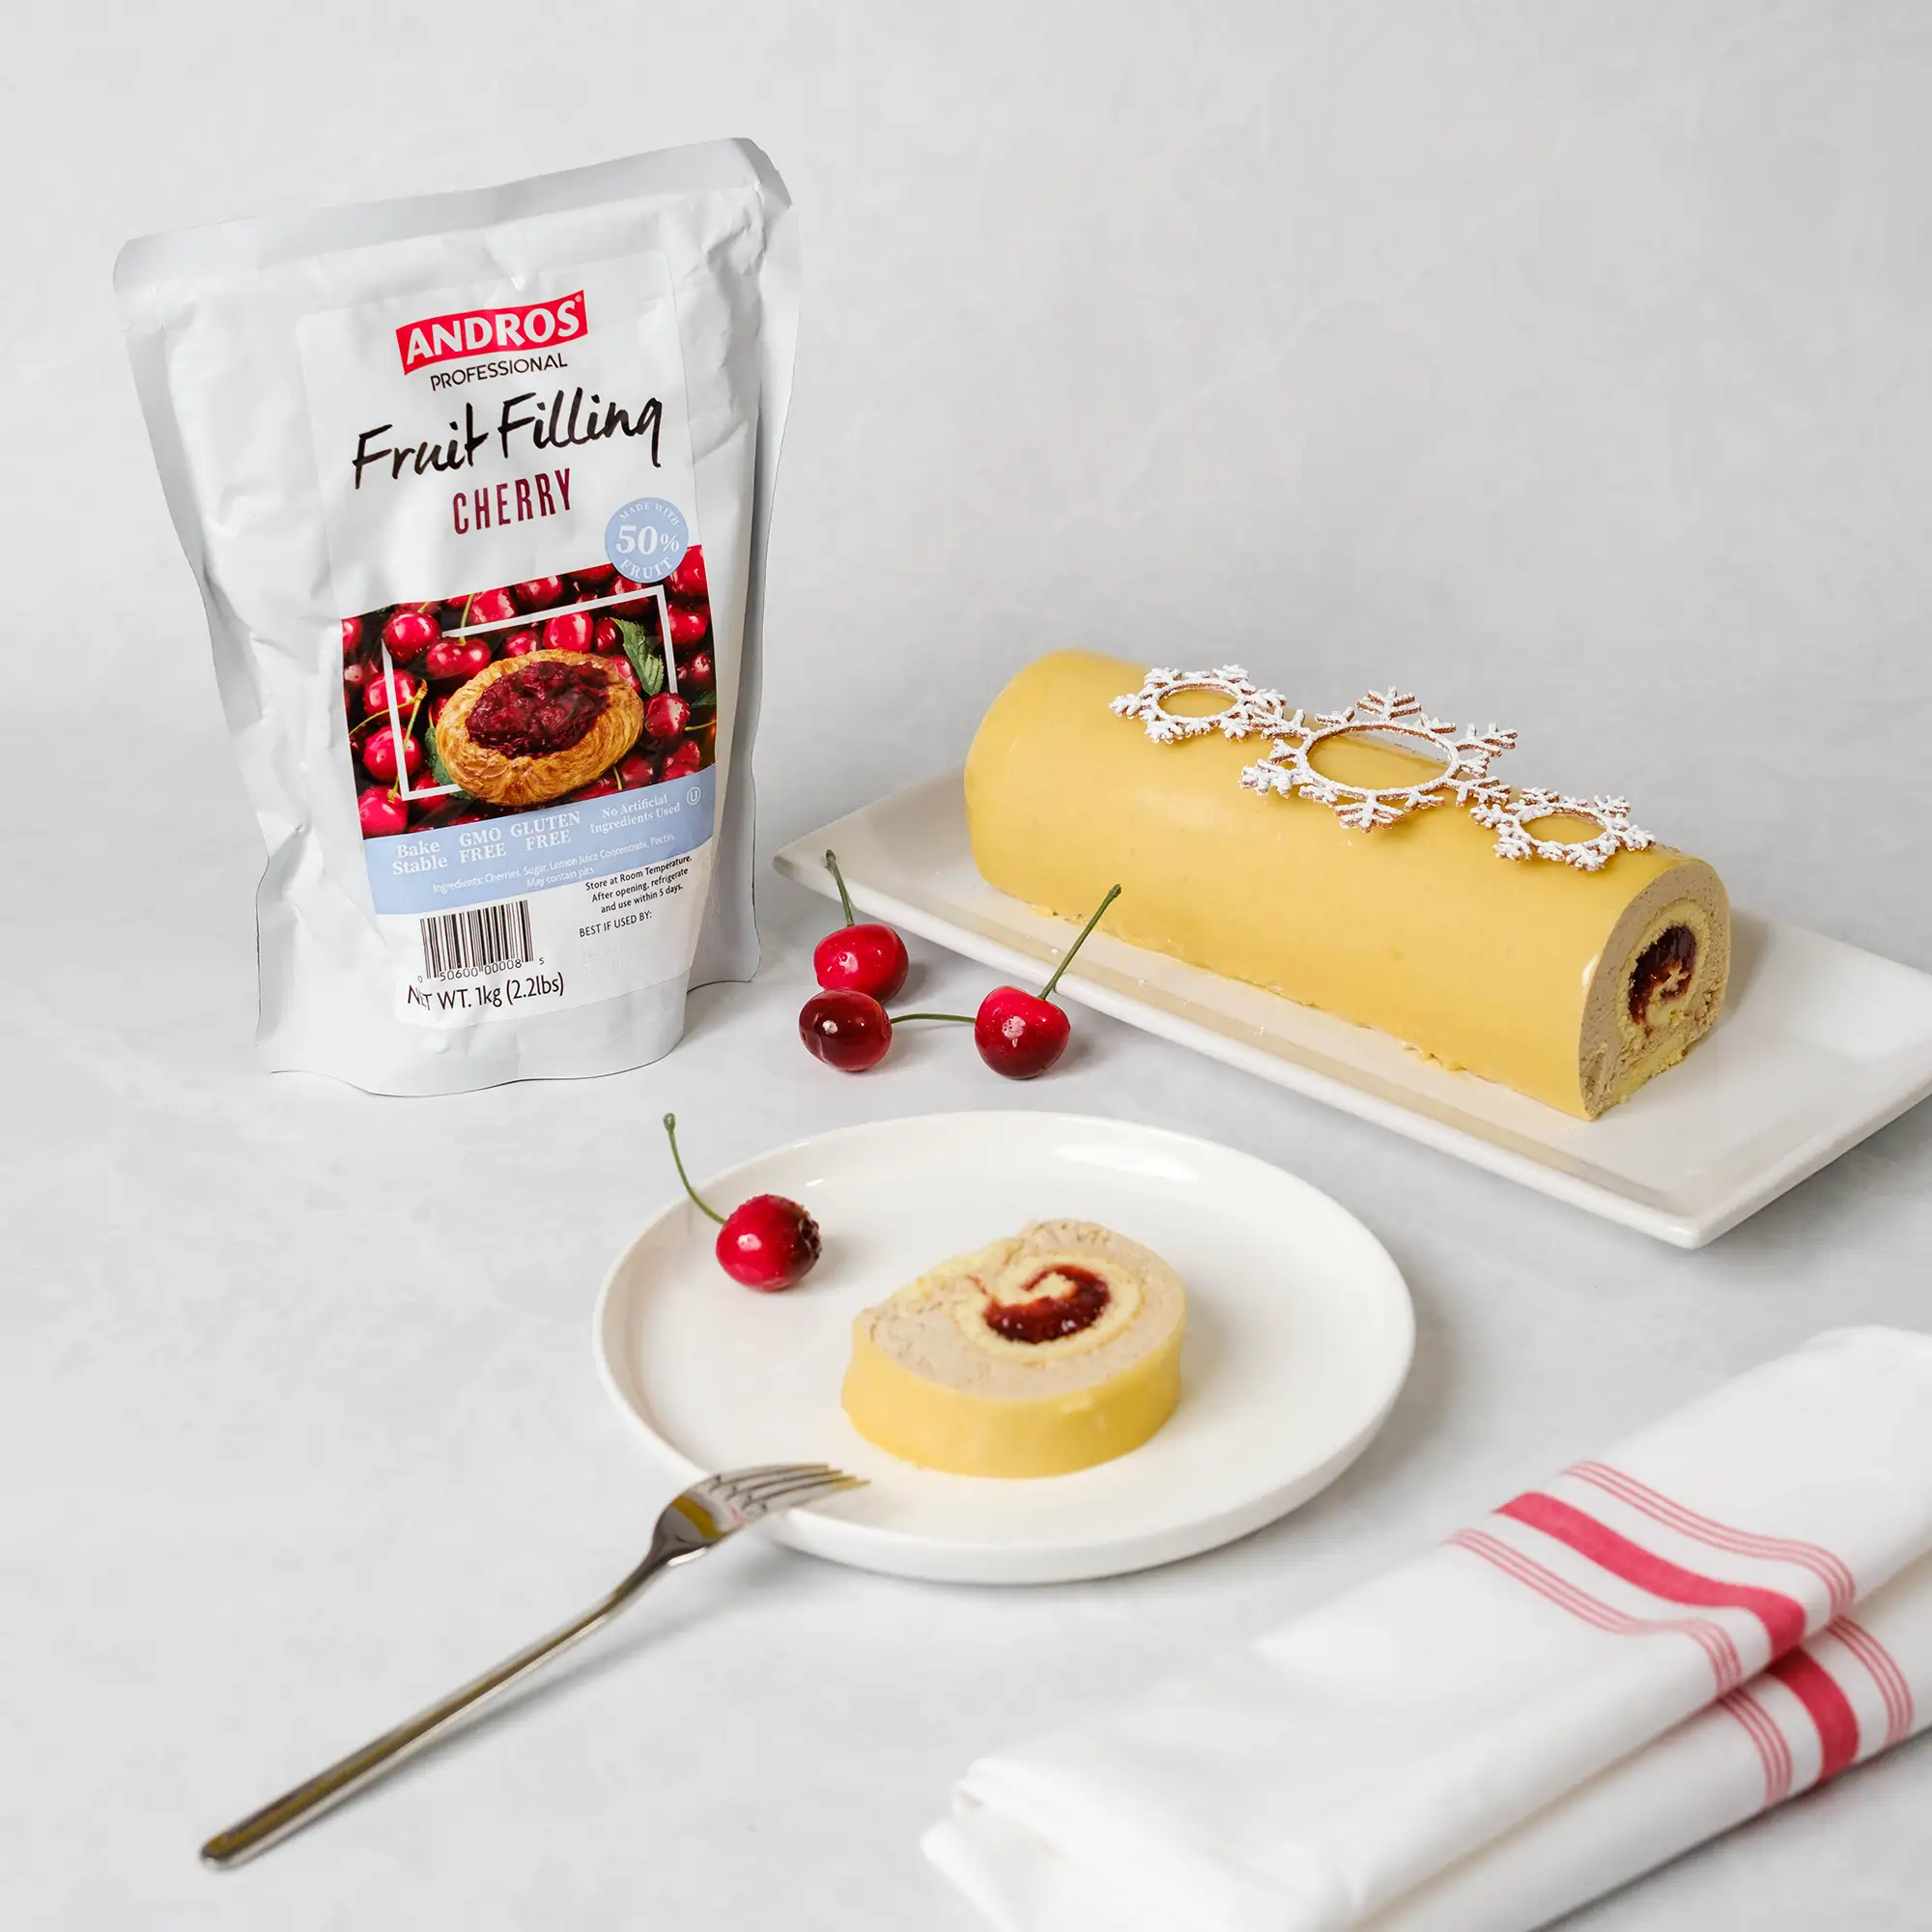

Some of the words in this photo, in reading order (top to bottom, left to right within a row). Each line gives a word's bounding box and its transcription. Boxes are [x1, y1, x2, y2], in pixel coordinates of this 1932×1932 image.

[431, 353, 568, 391] PROFESSIONAL
[352, 403, 489, 490] Fruit
[497, 387, 663, 469] Filling
[453, 468, 571, 535] CHERRY
[620, 502, 650, 522] MADE
[655, 503, 680, 526] WITH
[615, 524, 680, 555] 50%
[619, 556, 672, 579] FRUIT
[589, 811, 654, 836] Ingredients
[656, 802, 681, 819] Used
[603, 808, 617, 819] No
[620, 793, 668, 815] Artificial
[459, 827, 501, 847] GMO
[510, 810, 581, 838] GLUTEN
[396, 840, 440, 858] Bake
[459, 842, 506, 865] FREE
[526, 829, 572, 851] FREE
[392, 855, 448, 875] Stable
[433, 878, 484, 895] Ingredients:
[550, 857, 578, 870] Lemon
[579, 853, 598, 866] Juice
[650, 832, 675, 847] Pectin.
[526, 876, 545, 889] May
[546, 869, 578, 884] contain
[579, 866, 594, 877] pits
[585, 879, 608, 891] Store
[610, 876, 618, 886] at
[620, 870, 643, 883] Room
[645, 855, 693, 875] Temperature.
[591, 891, 613, 902] After
[615, 883, 650, 897] opening,
[651, 867, 689, 887] refrigerate
[601, 901, 616, 914] and
[618, 899, 632, 909] use
[634, 890, 658, 905] within
[659, 888, 665, 897] 5
[666, 883, 684, 895] days.
[579, 923, 601, 938] BEST
[603, 921, 611, 932] IF
[613, 914, 638, 928] USED
[639, 910, 653, 922] BY:
[417, 975, 423, 983] 0
[440, 967, 478, 982] 50600
[484, 958, 523, 976] 00008
[539, 956, 545, 966] 5
[408, 984, 432, 1010] NET
[437, 988, 472, 1010] WT.
[475, 985, 502, 1007] 1kg
[506, 972, 564, 1006] (2.2lbs)
